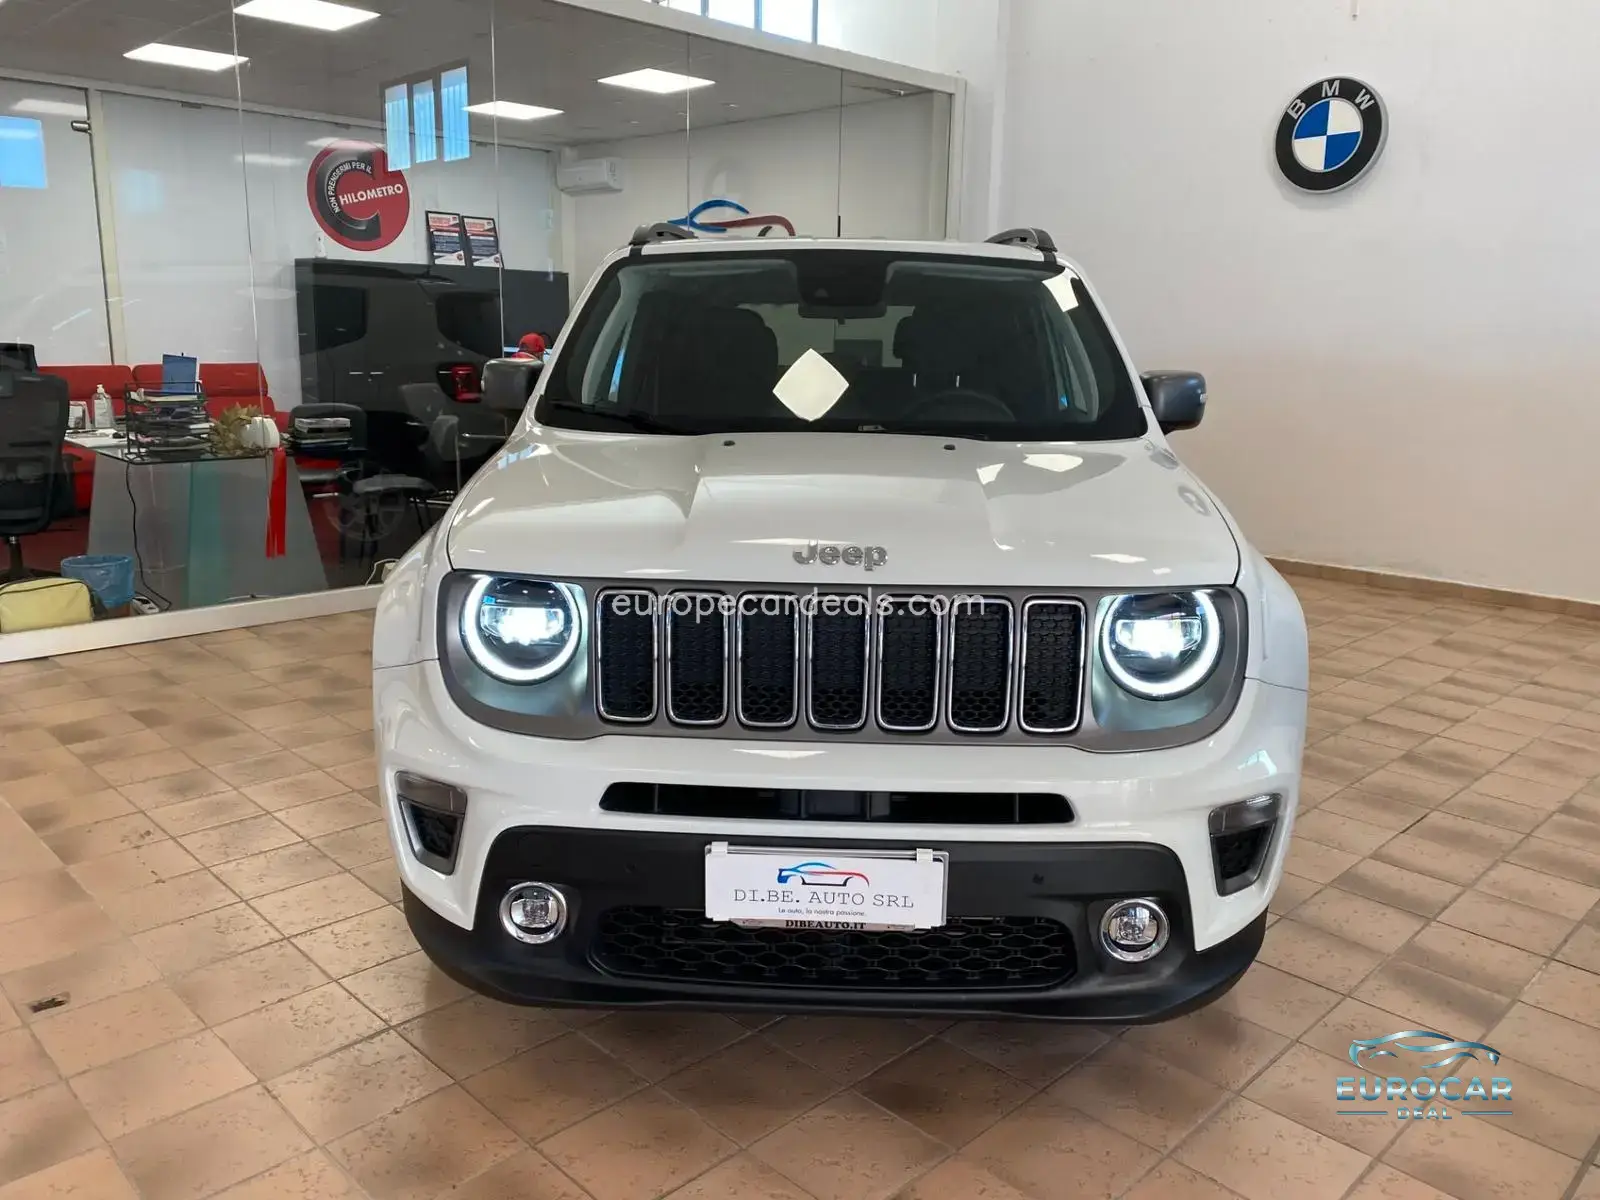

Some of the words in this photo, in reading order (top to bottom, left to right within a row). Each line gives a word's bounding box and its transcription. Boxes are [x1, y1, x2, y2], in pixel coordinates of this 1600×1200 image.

[1286, 79, 1375, 120] BMW
[351, 161, 366, 170] PER
[328, 162, 352, 196] PRENDERMI
[329, 197, 341, 214] NON
[792, 539, 888, 572] Jeep
[734, 888, 801, 903] DI.BE.
[808, 891, 865, 906] AUTO
[872, 894, 914, 909] SRL
[785, 919, 867, 931] DIBEAUTO.IT
